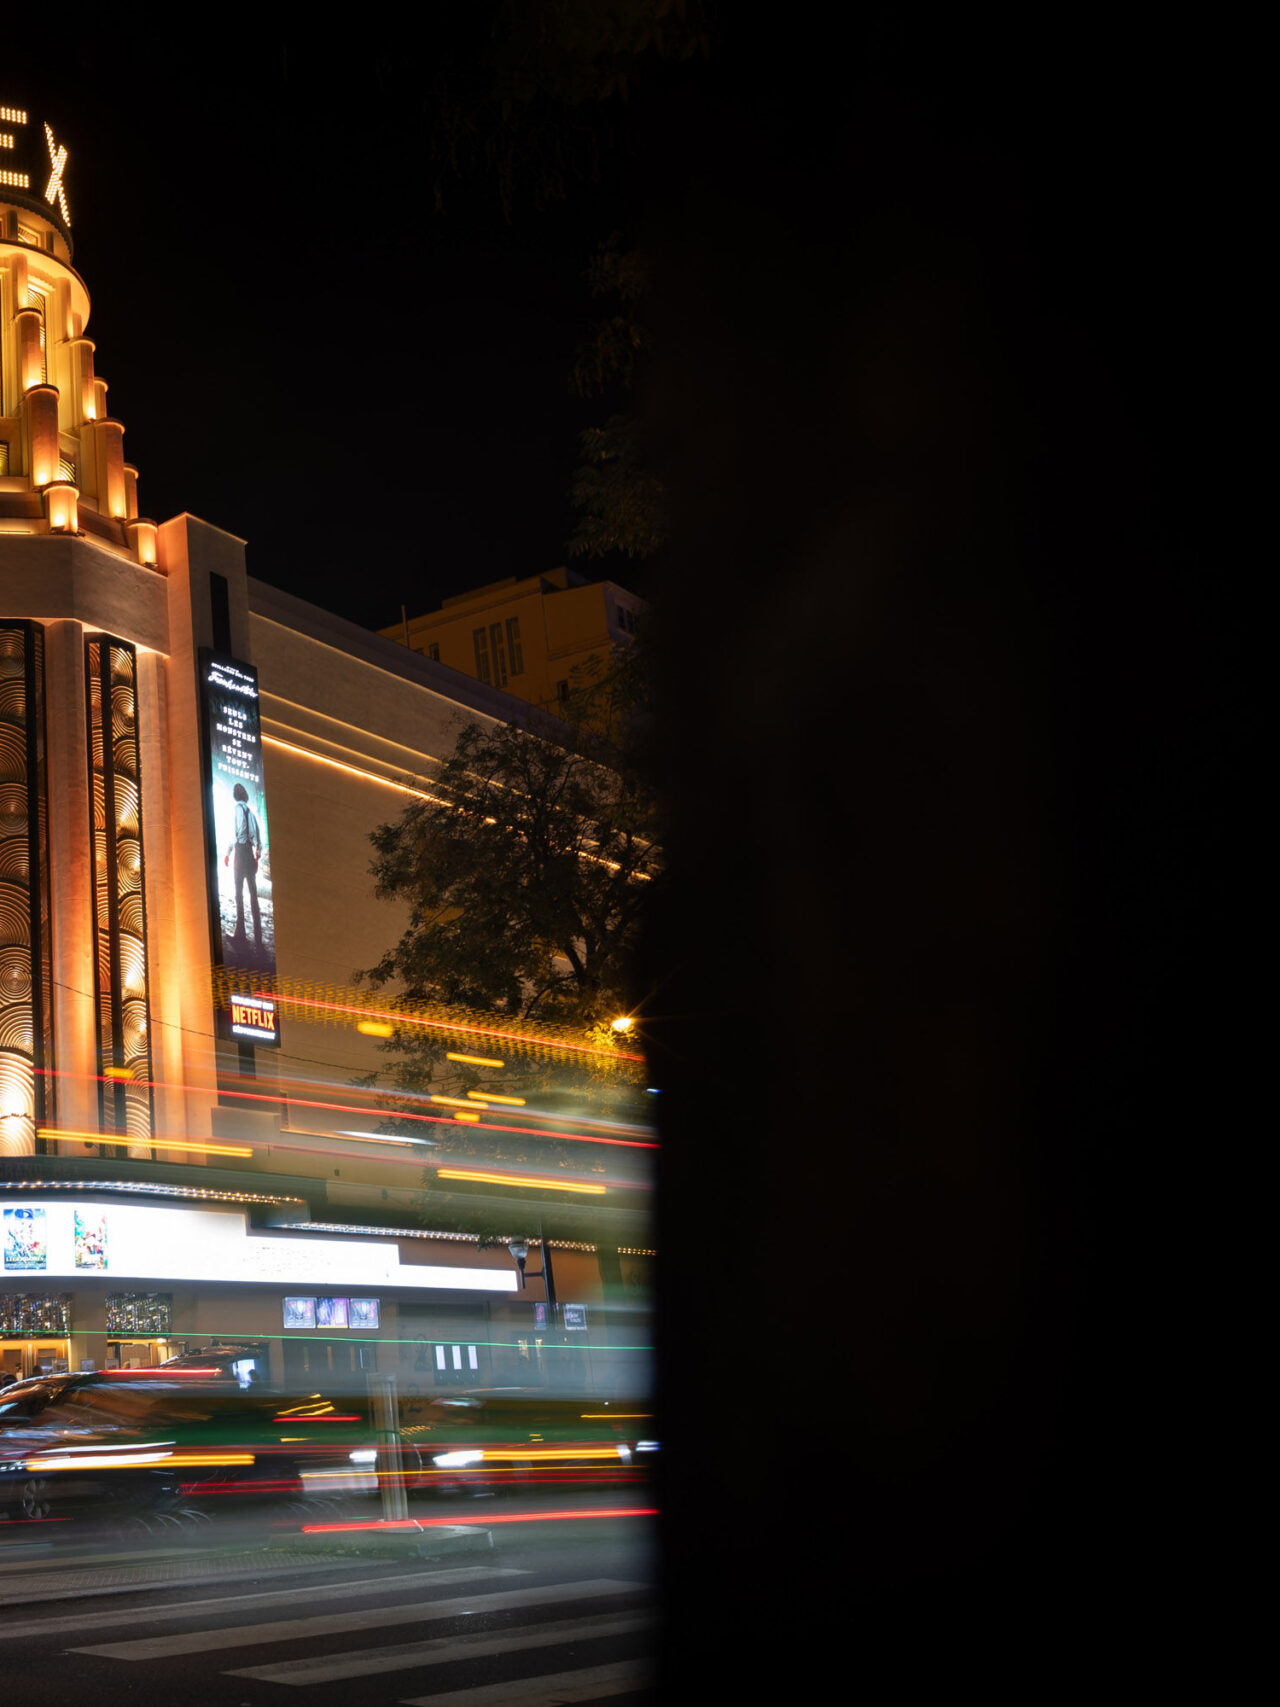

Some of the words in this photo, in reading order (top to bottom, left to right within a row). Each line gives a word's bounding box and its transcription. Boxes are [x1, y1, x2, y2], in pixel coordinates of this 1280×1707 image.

[223, 706, 247, 721] SEULS
[228, 717, 243, 729] LES
[216, 723, 256, 743] MONSTRES
[232, 1004, 275, 1031] NETFLIX
